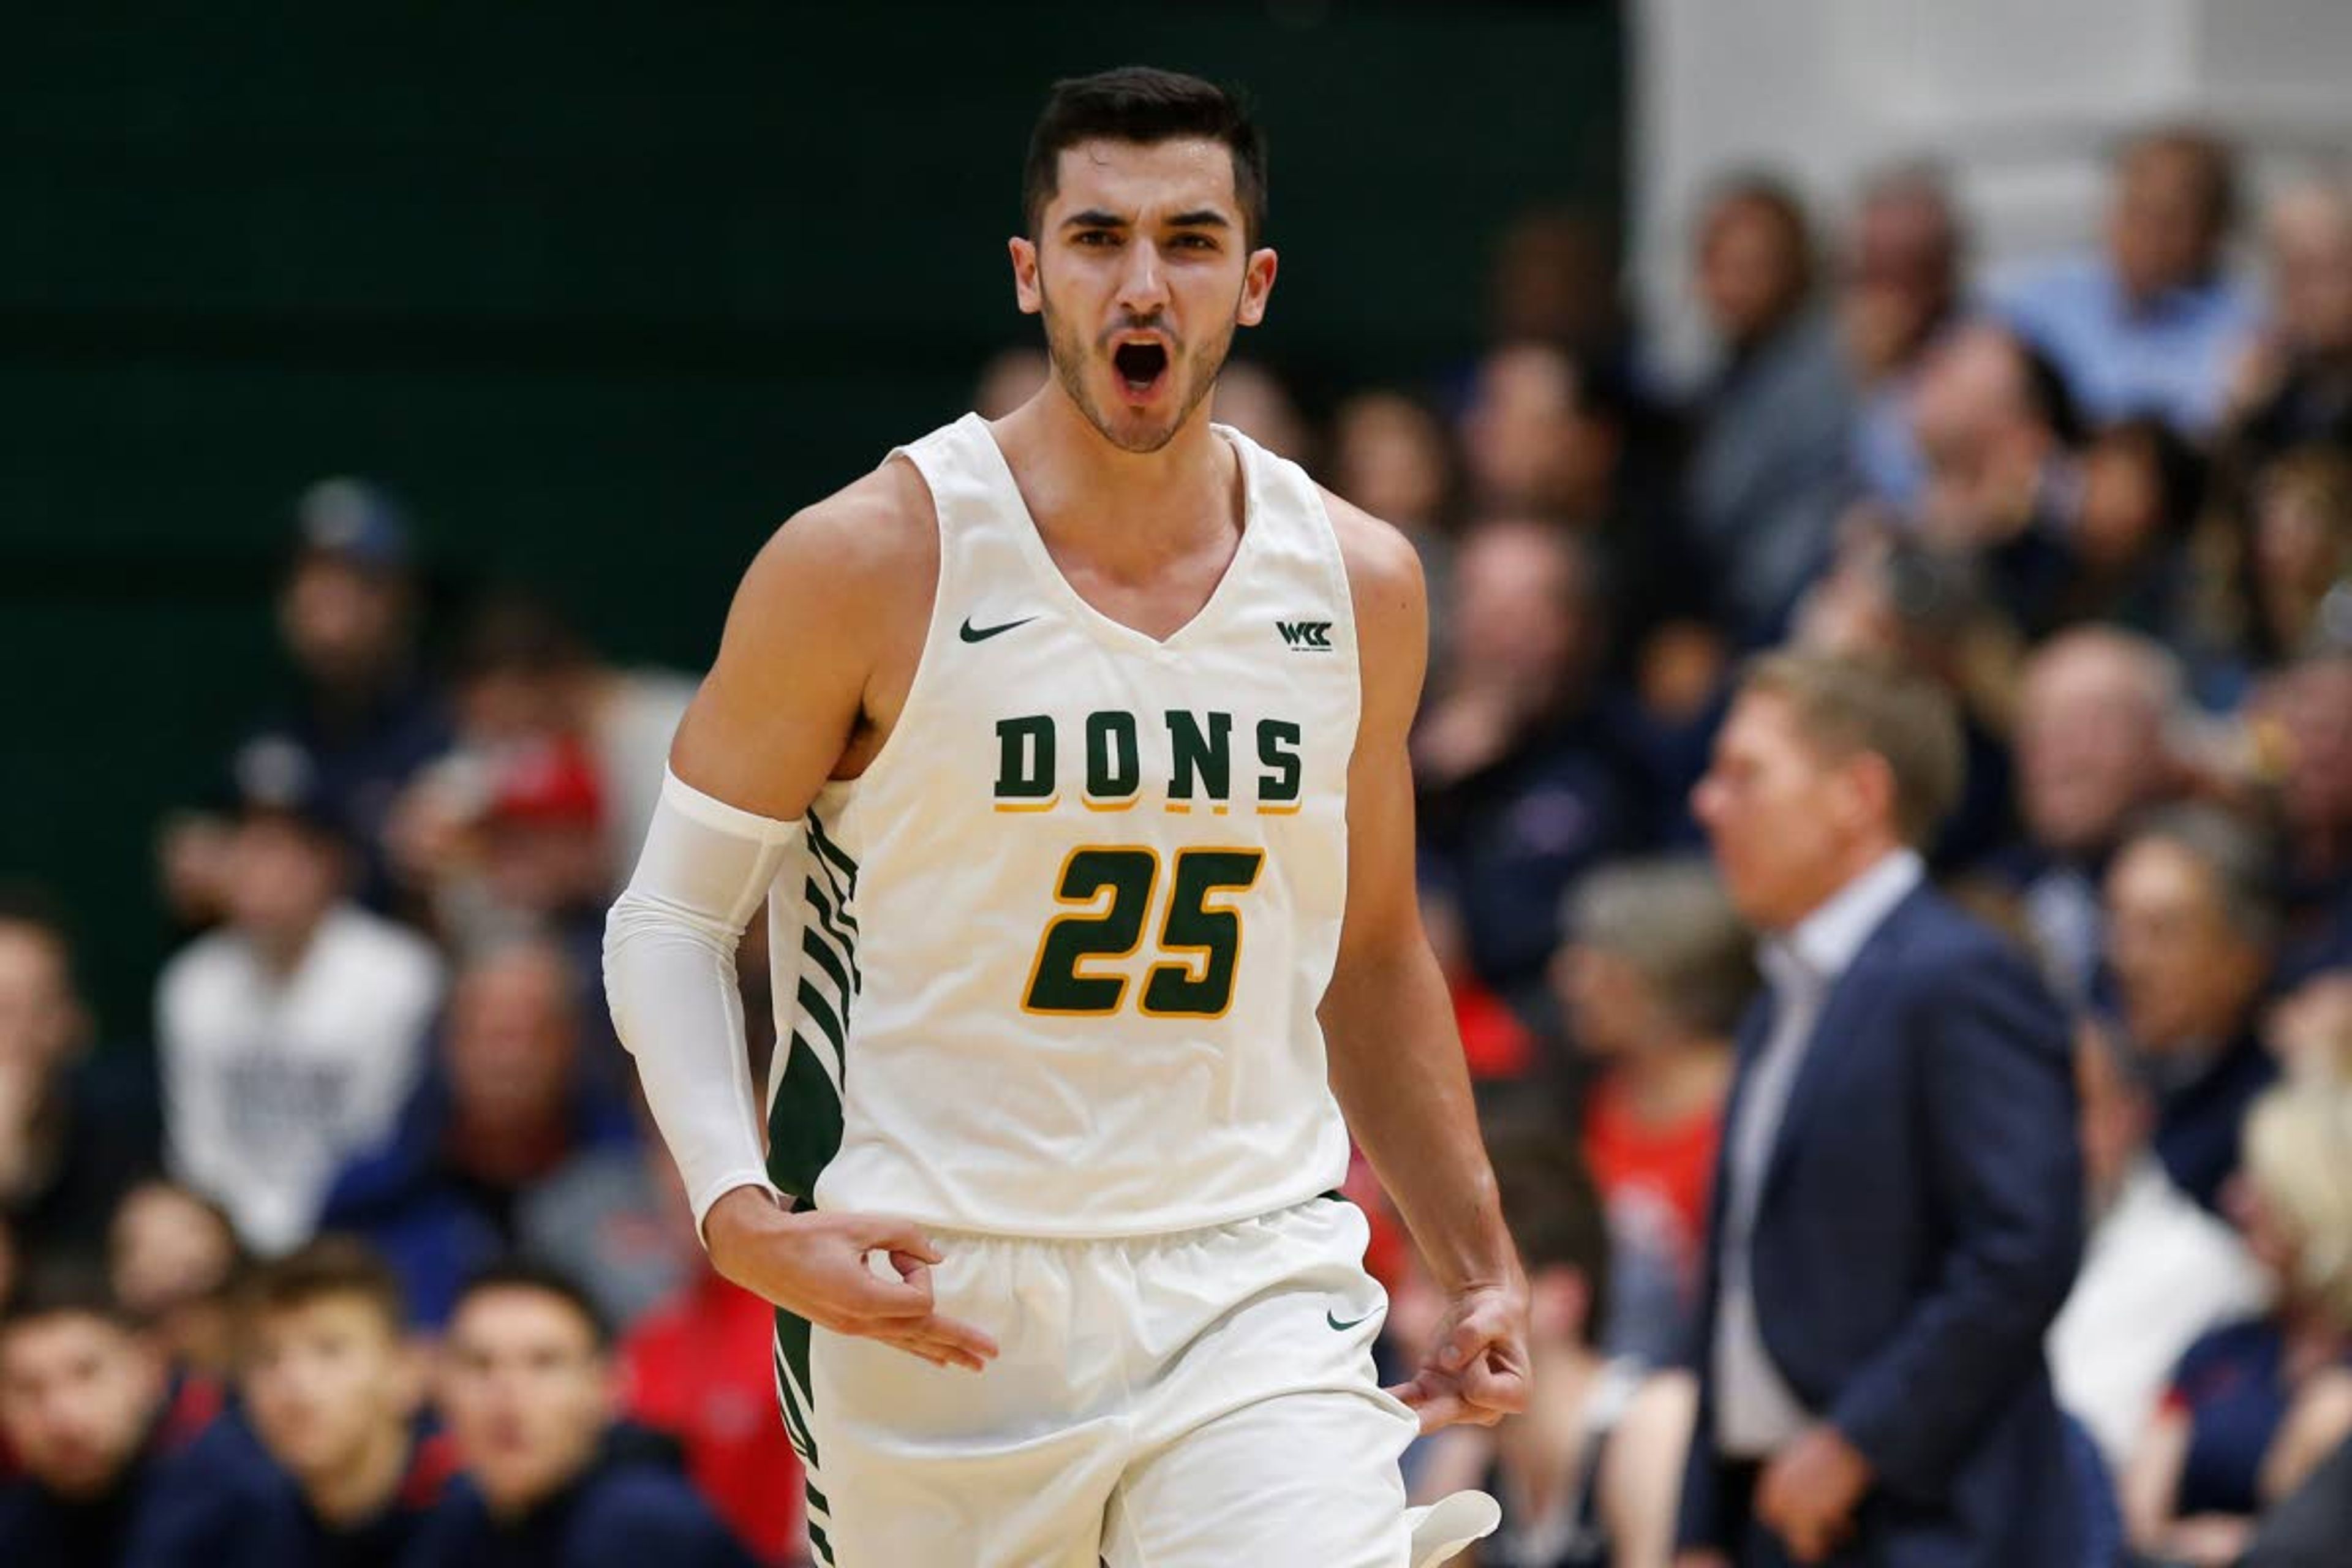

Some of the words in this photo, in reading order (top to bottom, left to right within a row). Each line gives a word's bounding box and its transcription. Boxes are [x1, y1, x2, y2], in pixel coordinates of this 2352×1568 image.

[1276, 621, 1332, 646] WCC
[993, 710, 1302, 815] DONS
[1020, 845, 1267, 1019] 25
